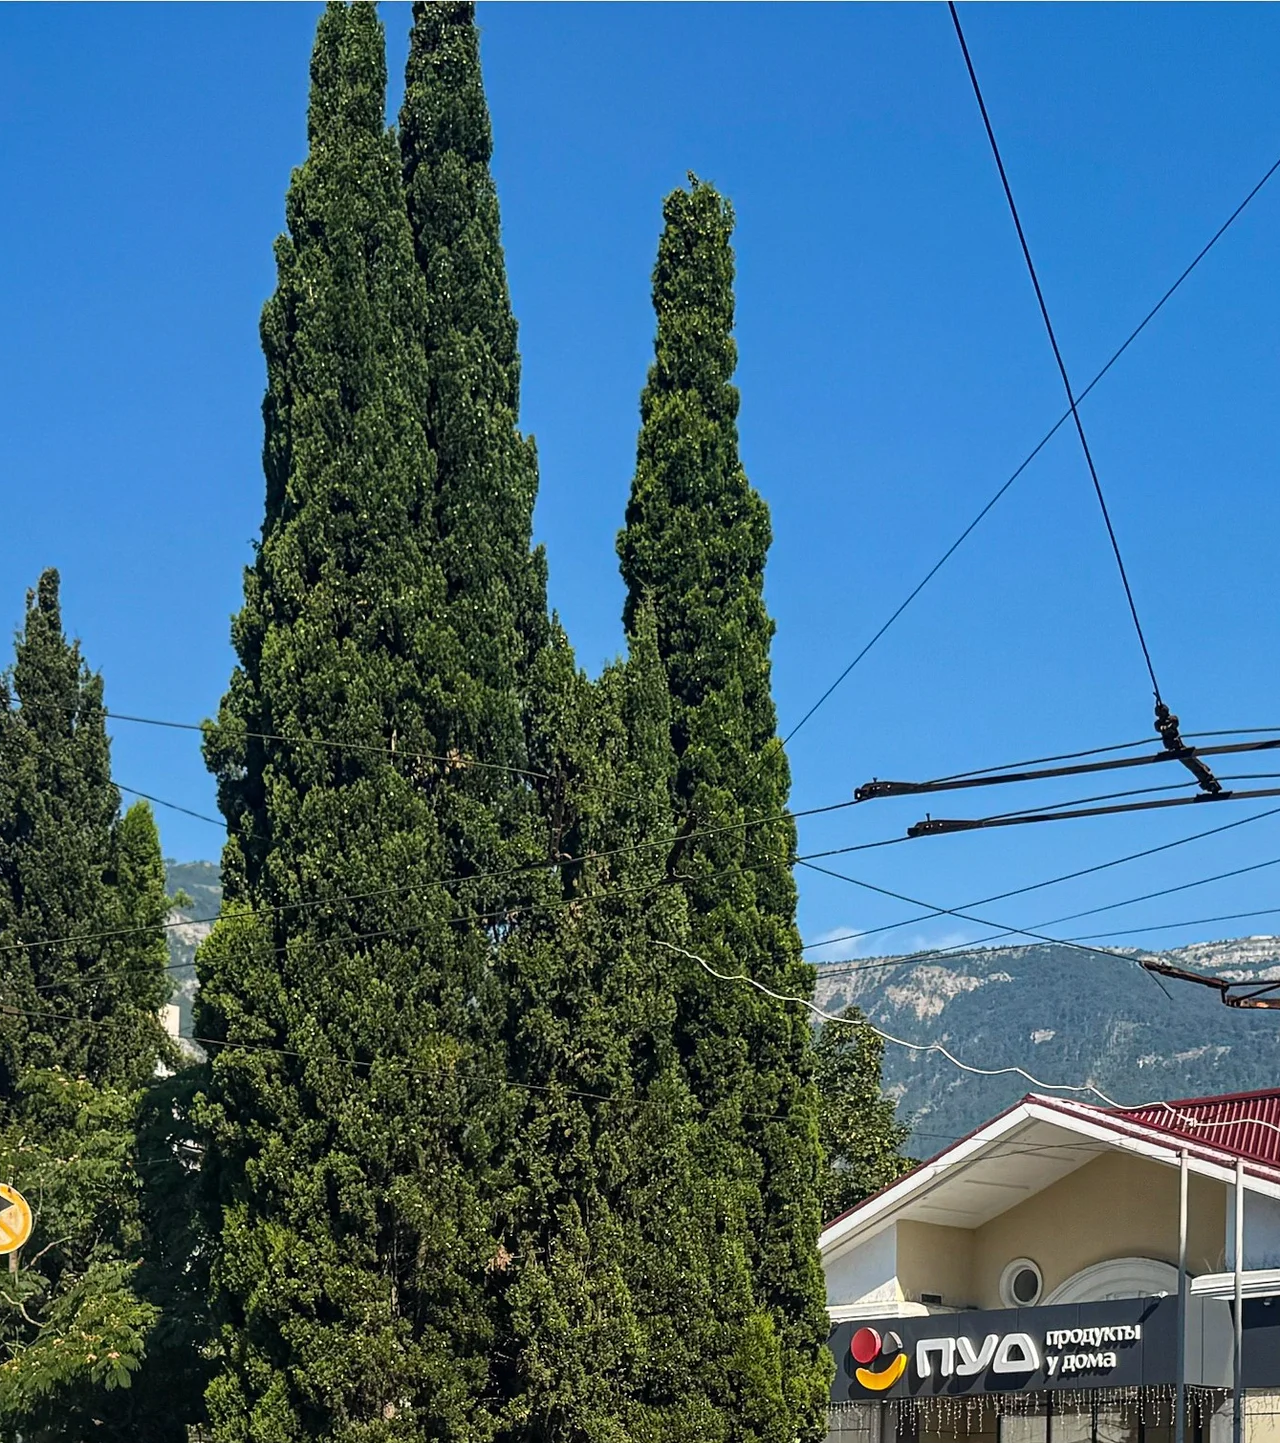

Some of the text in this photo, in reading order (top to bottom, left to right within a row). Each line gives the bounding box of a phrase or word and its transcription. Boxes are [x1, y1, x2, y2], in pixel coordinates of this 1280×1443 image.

[1045, 1324, 1141, 1350] продукты
[1046, 1351, 1118, 1376] у дома
